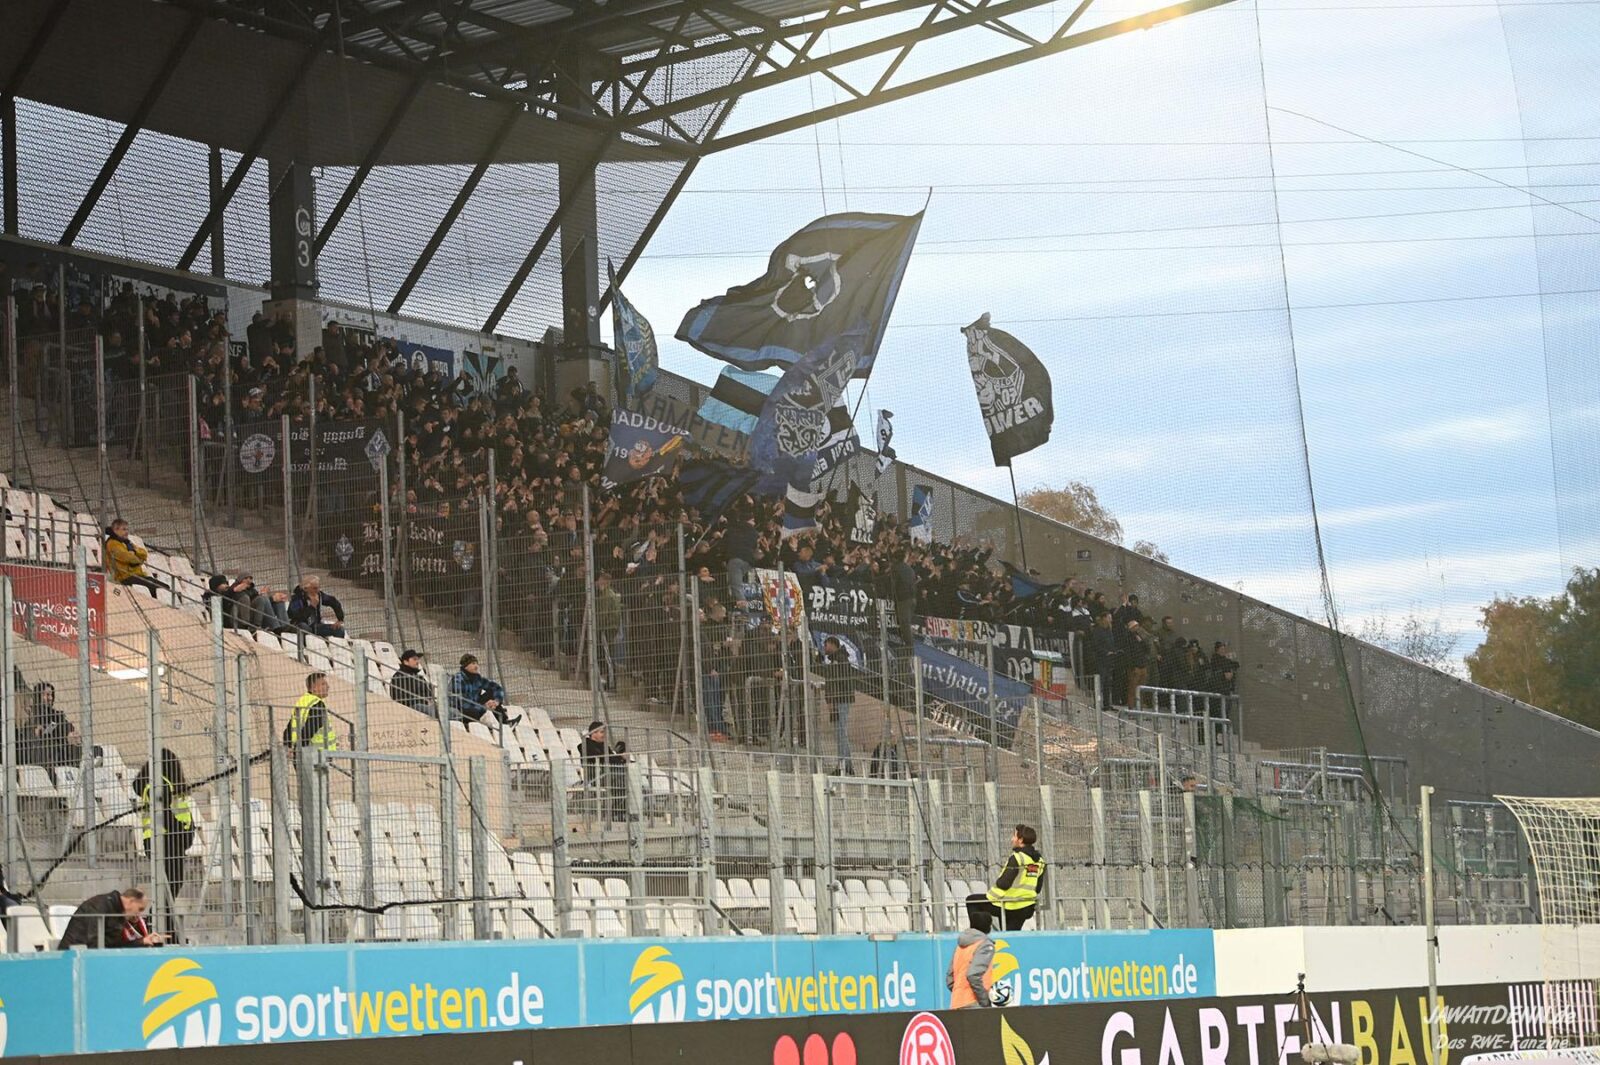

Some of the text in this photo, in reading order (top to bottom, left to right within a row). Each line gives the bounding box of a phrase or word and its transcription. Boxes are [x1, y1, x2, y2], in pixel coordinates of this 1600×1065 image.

[696, 961, 916, 1018] sportwetten.de
[1029, 954, 1197, 1002] sportwetten.de
[235, 971, 544, 1043] sportwetten.de
